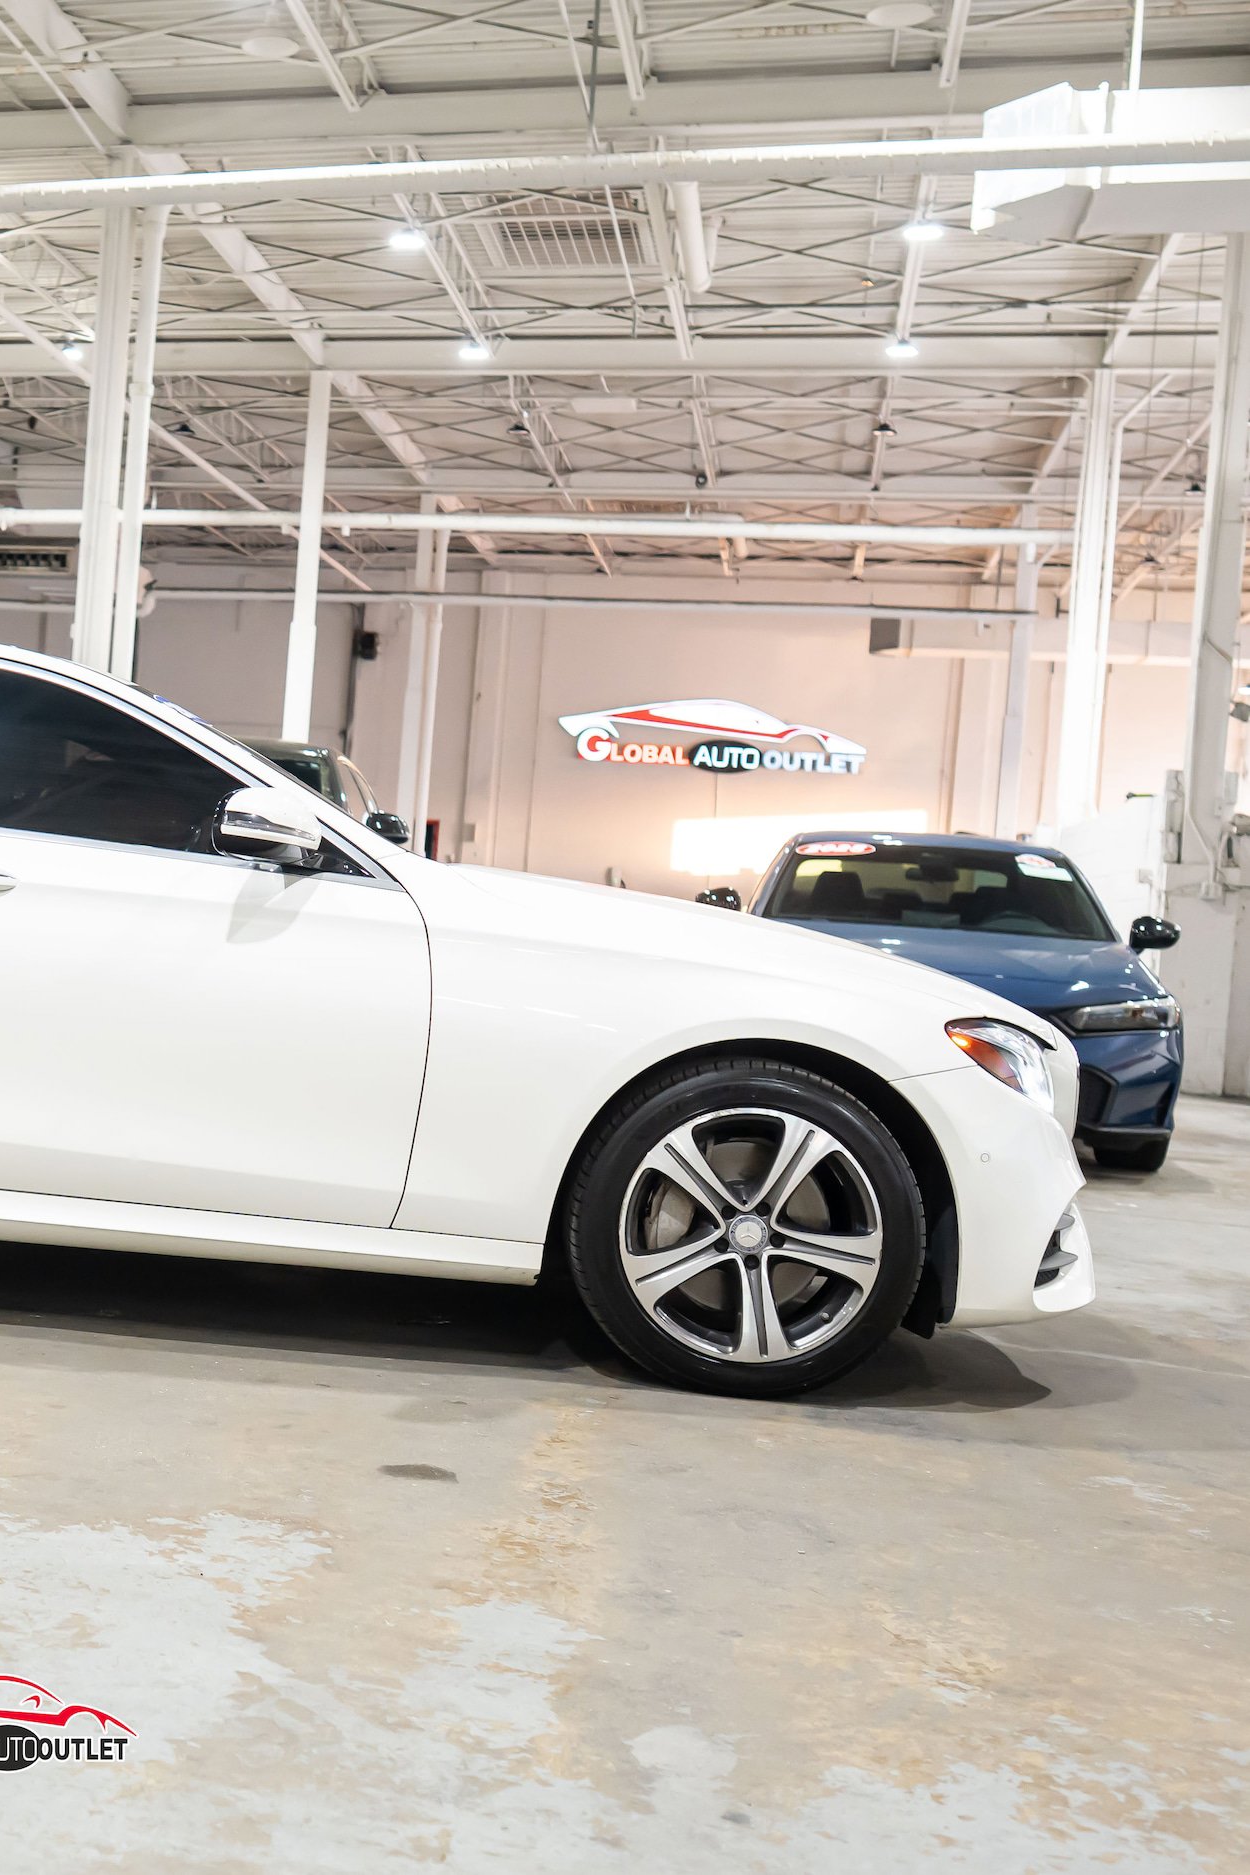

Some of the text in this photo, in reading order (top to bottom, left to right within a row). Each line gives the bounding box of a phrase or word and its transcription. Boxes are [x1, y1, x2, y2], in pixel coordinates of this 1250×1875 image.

[577, 727, 863, 775] GLOBAL AUTO OUTLET
